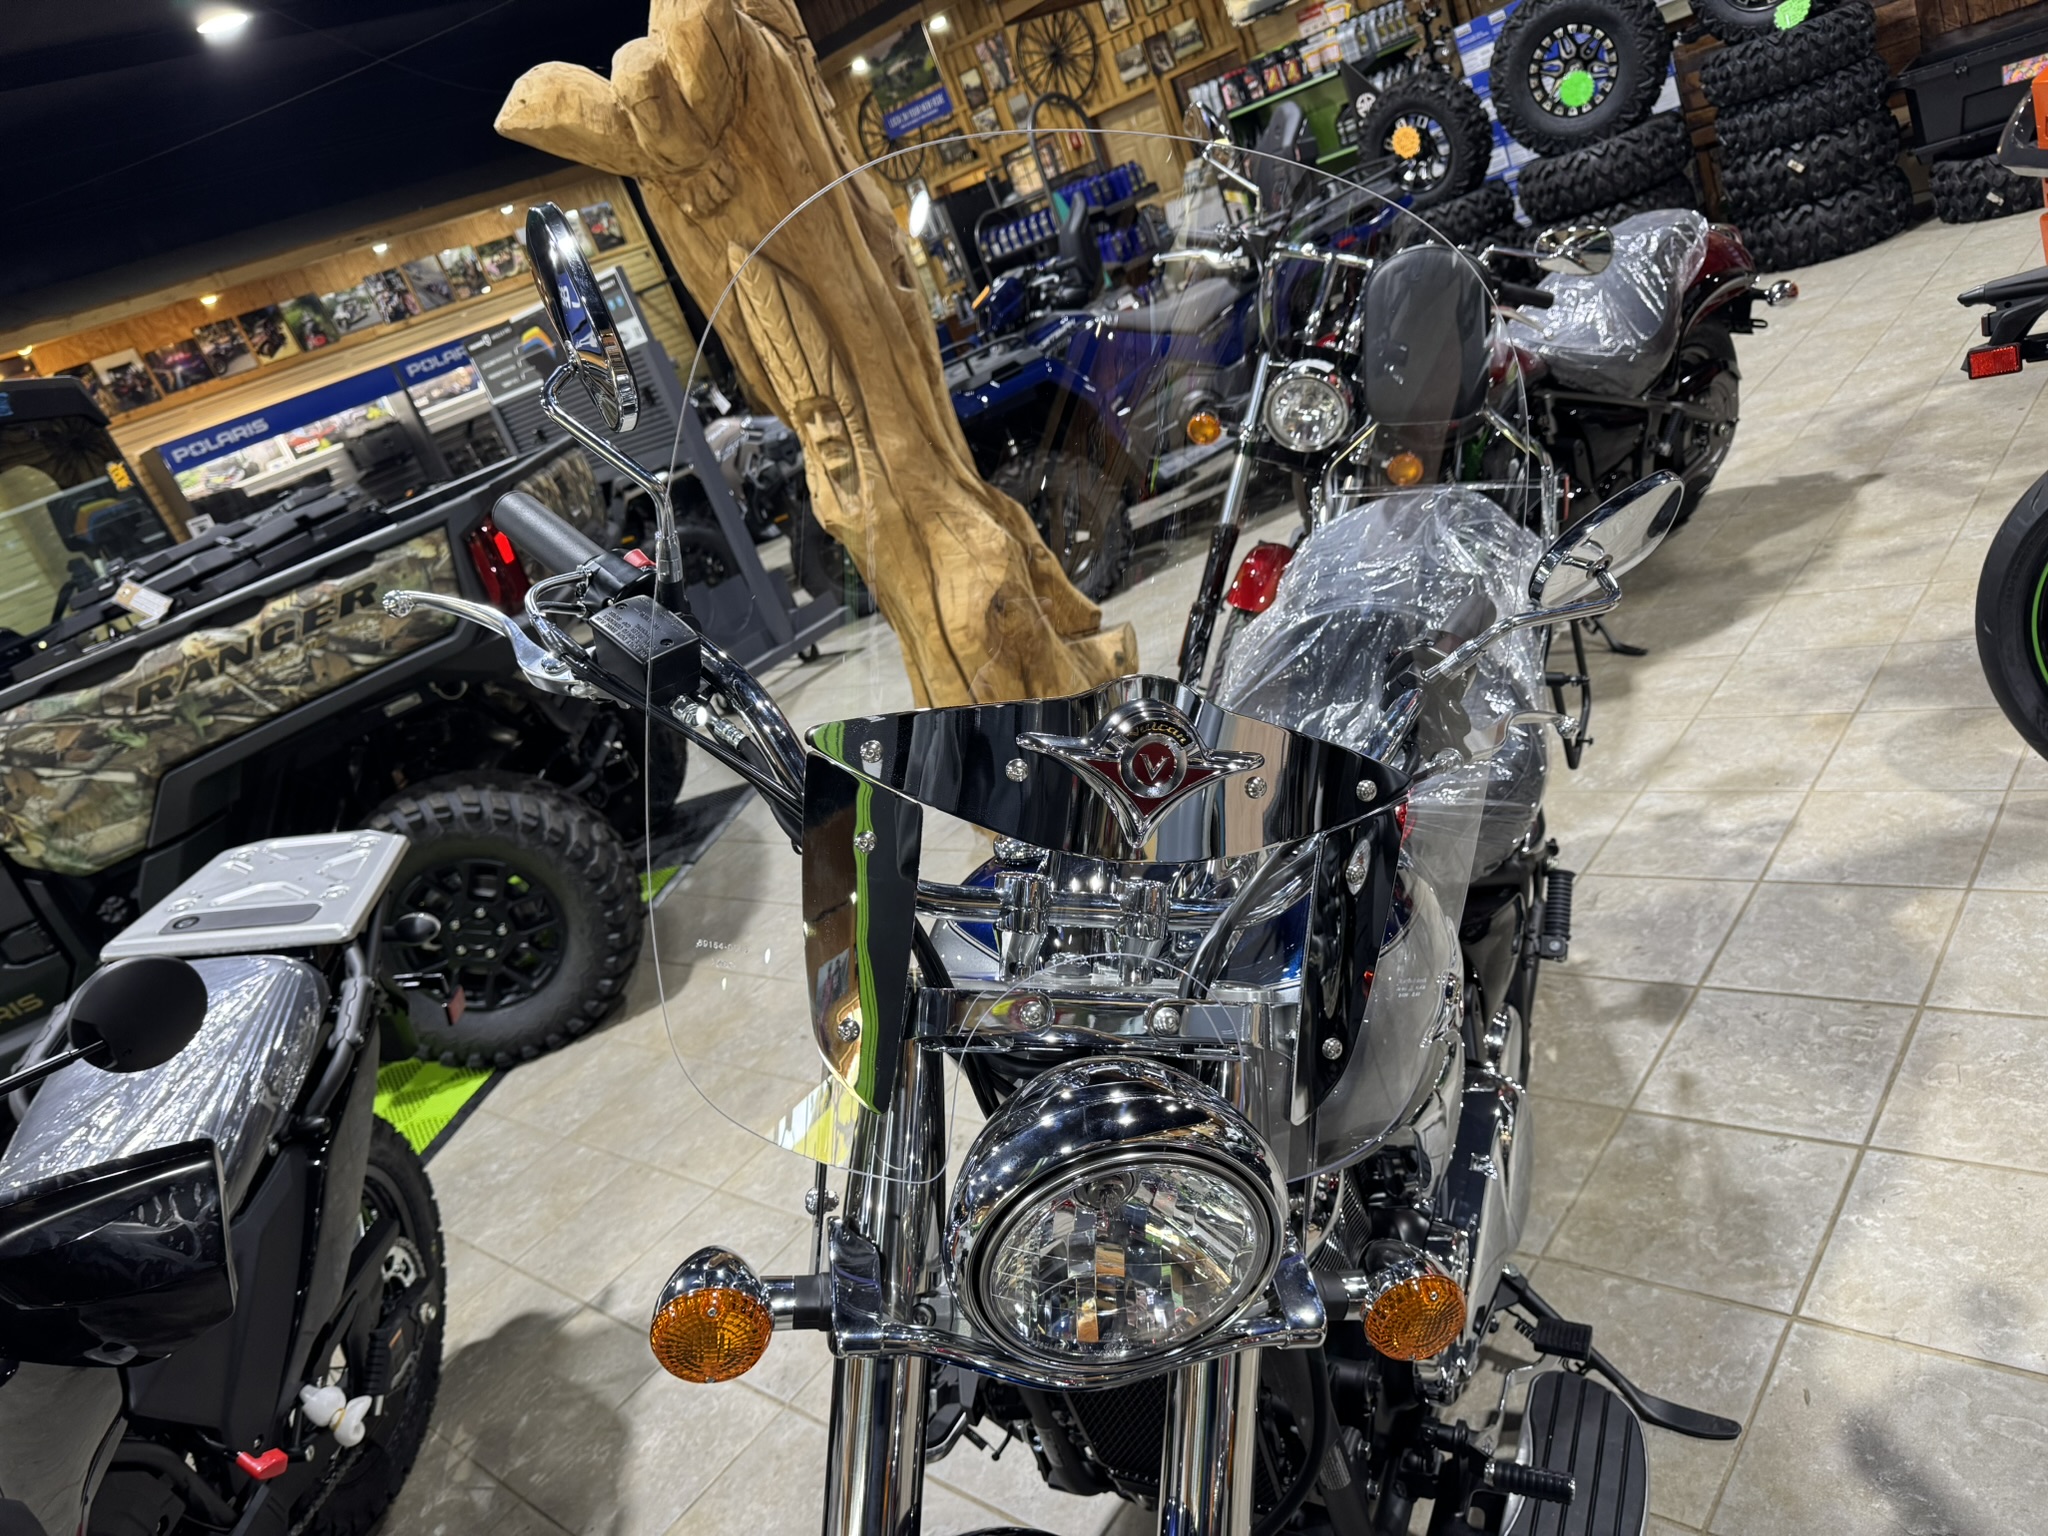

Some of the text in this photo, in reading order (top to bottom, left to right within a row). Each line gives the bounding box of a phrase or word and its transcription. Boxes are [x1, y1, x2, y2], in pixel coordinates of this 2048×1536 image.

[171, 418, 269, 463] POLARIS
[134, 581, 378, 714] RANGER
[1127, 722, 1187, 744] Vulcan
[1139, 753, 1170, 781] V
